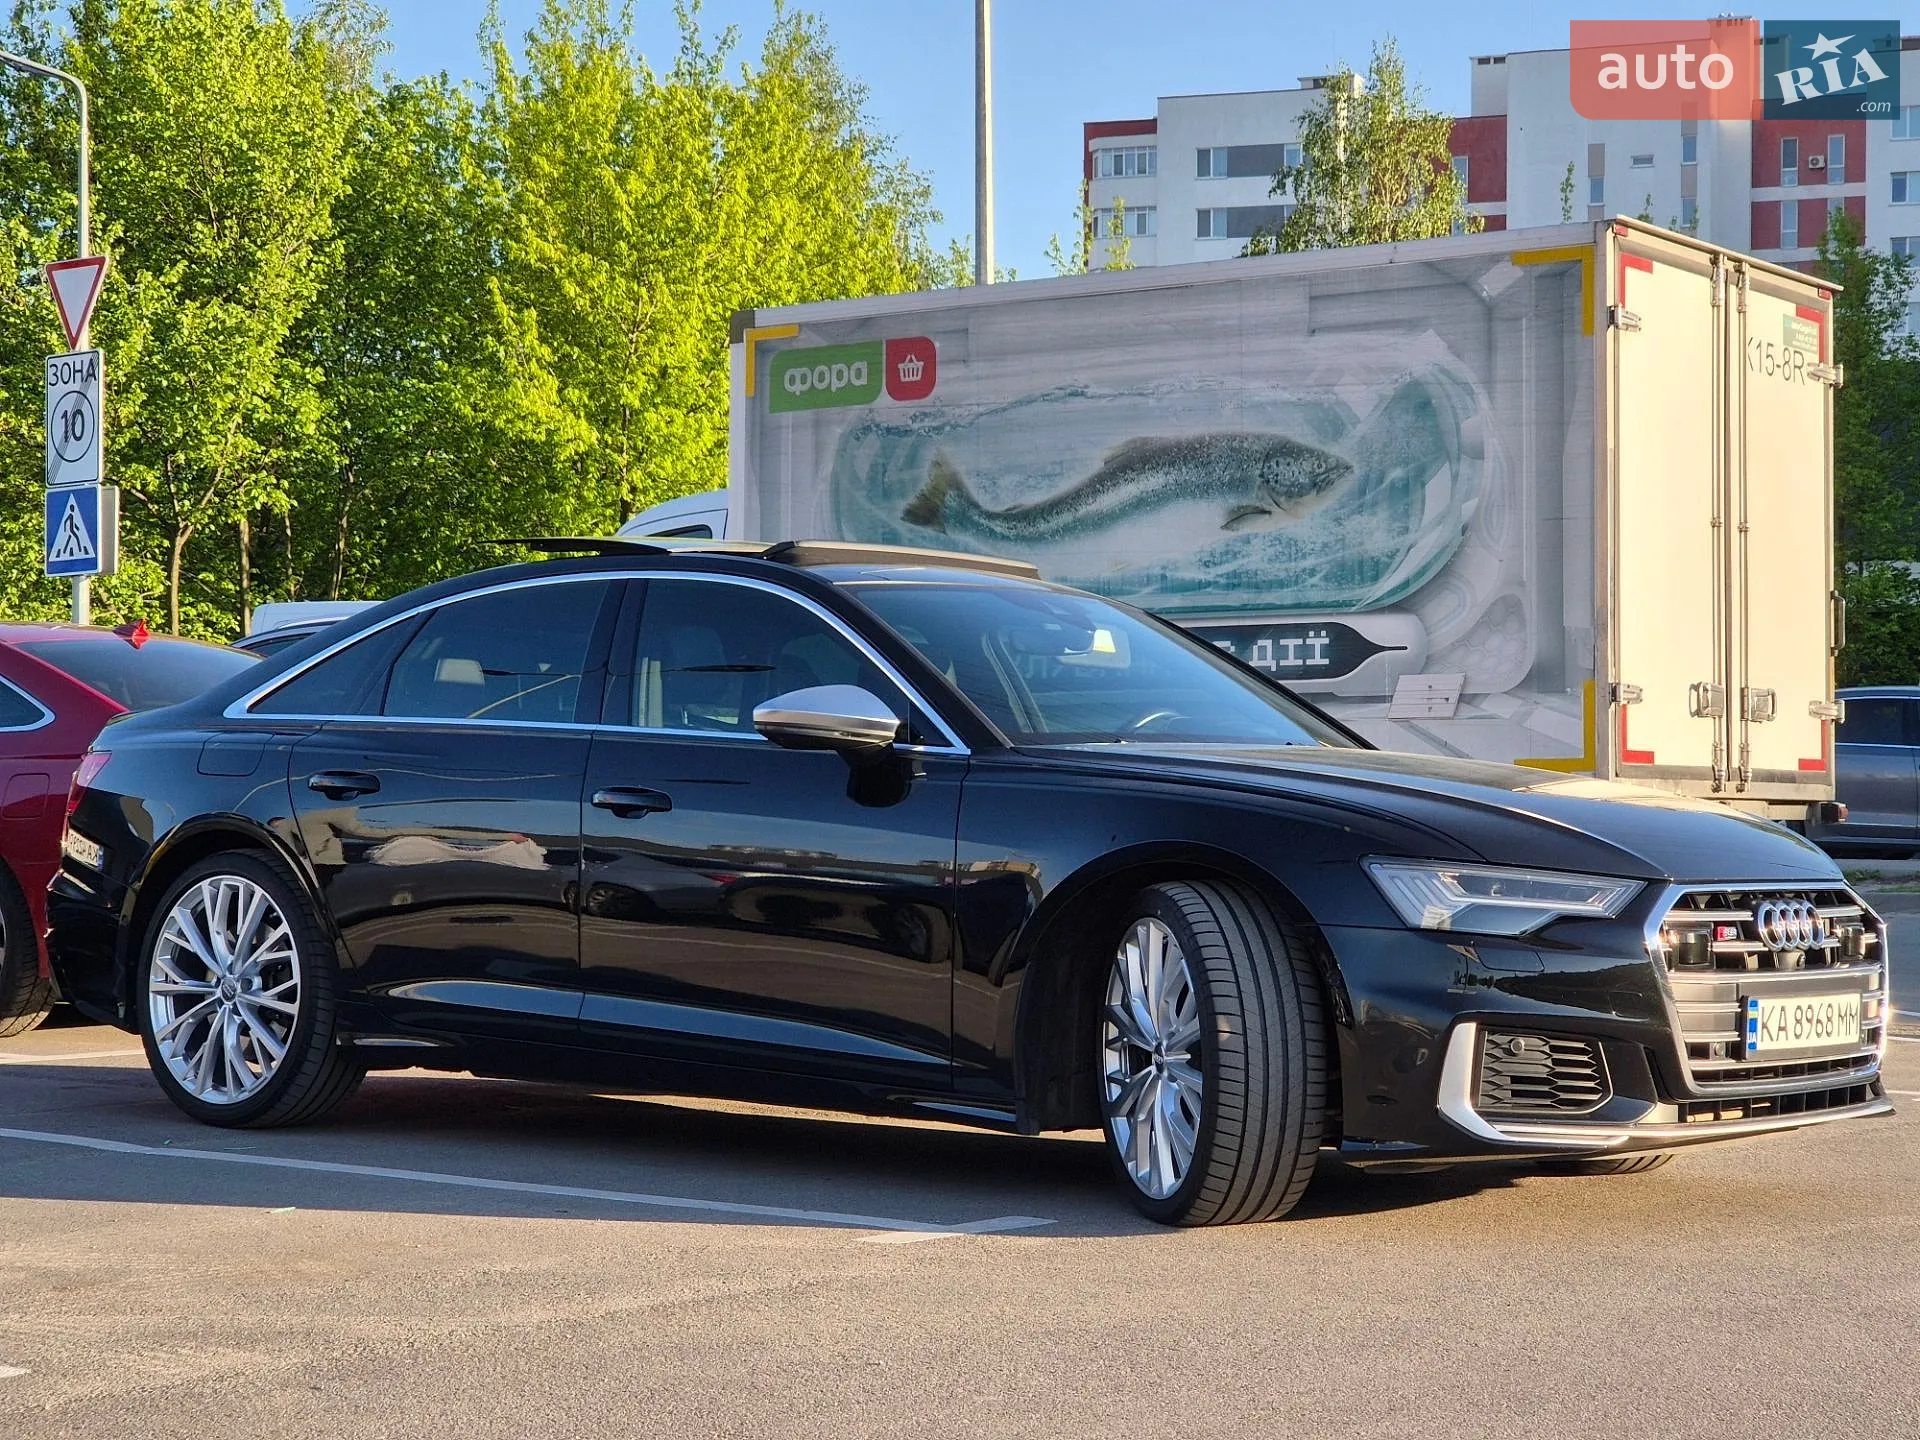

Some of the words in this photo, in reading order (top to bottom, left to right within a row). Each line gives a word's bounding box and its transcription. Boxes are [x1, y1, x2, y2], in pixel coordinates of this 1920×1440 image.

[48, 358, 98, 387] ЗОНА
[60, 408, 85, 443] 10
[1761, 1005, 1789, 1042] KA
[1793, 1002, 1834, 1040] 8968
[1837, 1001, 1859, 1037] MM
